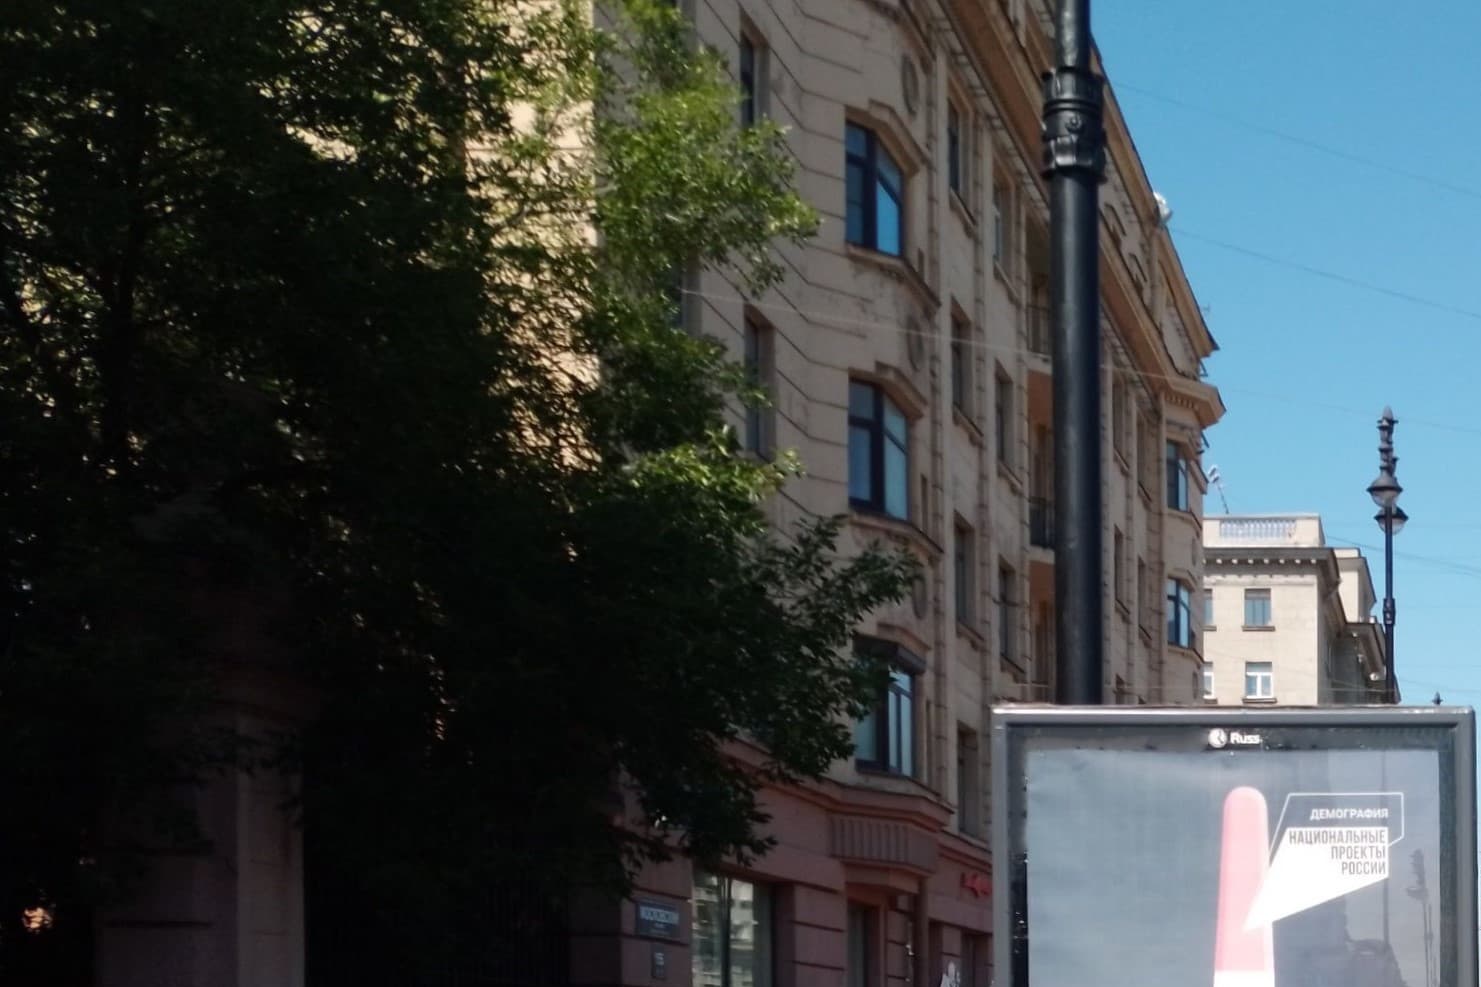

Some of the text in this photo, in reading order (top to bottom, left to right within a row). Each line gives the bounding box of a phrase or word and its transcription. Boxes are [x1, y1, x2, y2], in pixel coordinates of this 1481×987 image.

[1310, 808, 1389, 821] ДЕМОГРАФИЯ
[1289, 830, 1386, 845] НАЦИОНАЛЬНЫЕ
[1331, 846, 1386, 860] ПРОЕКТЫ
[1342, 861, 1386, 875] РОССИИ
